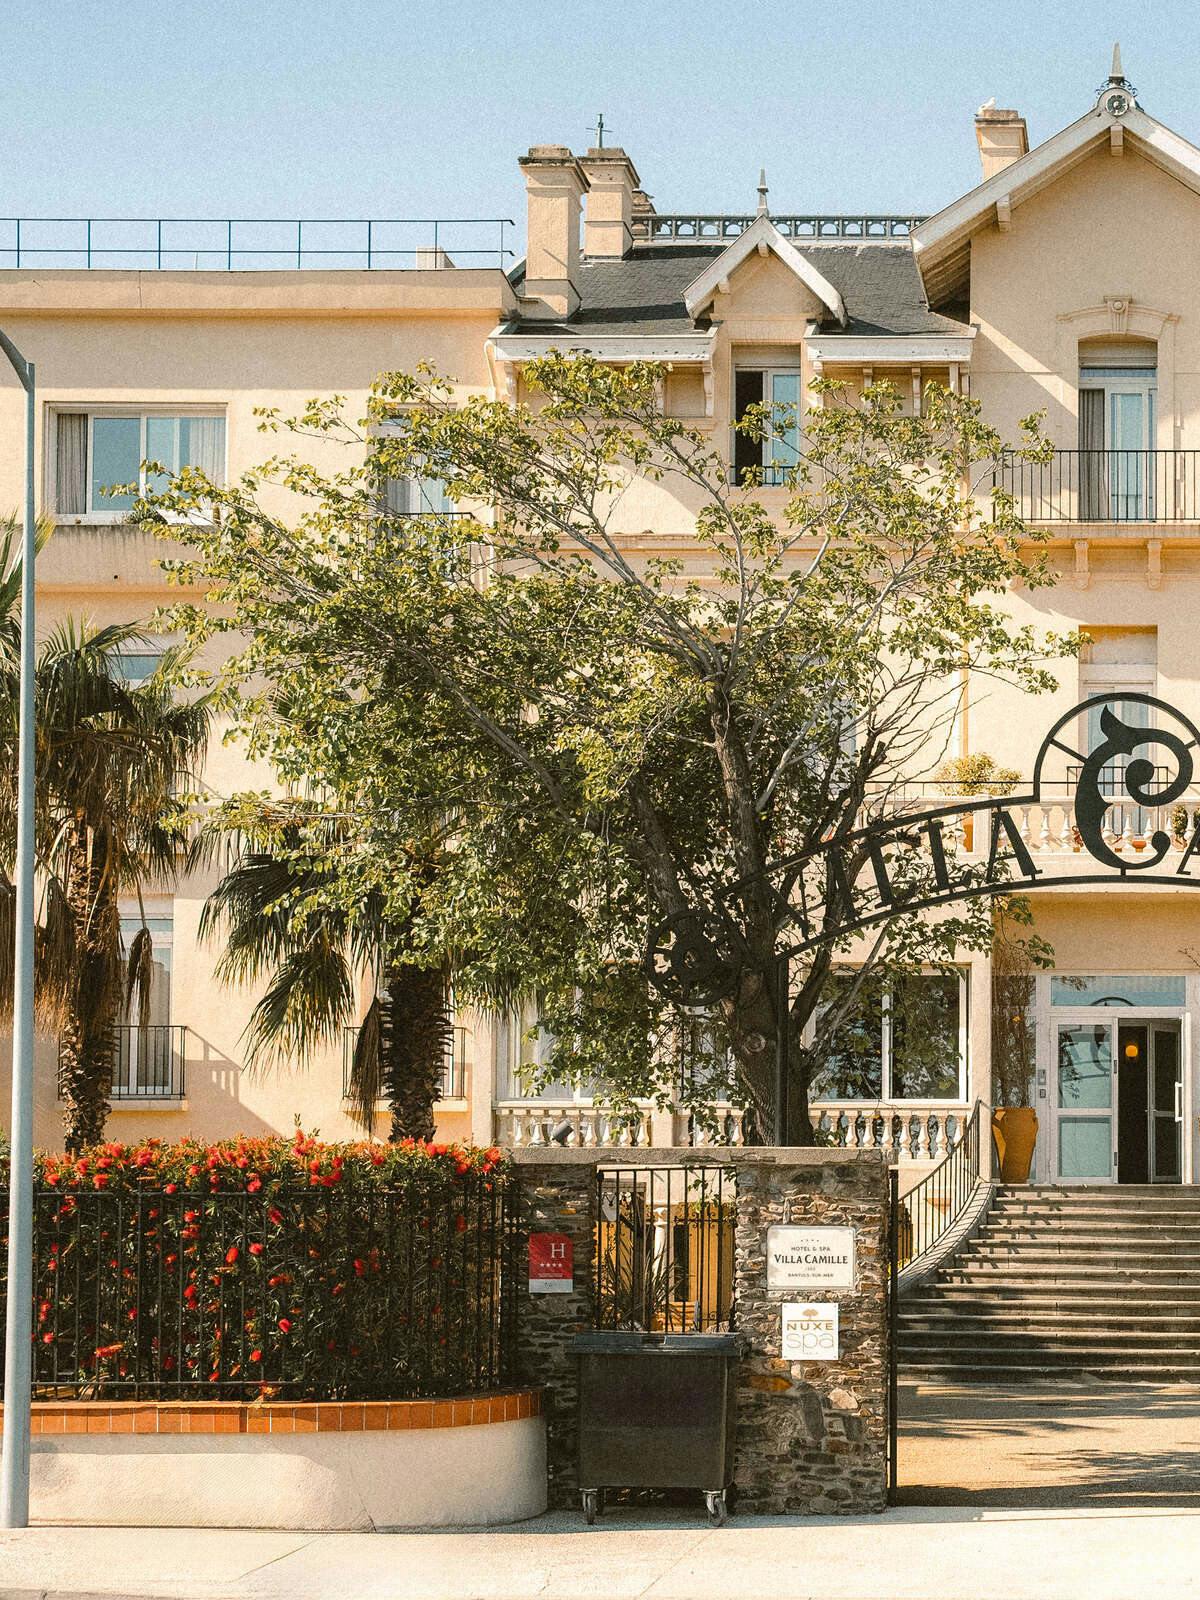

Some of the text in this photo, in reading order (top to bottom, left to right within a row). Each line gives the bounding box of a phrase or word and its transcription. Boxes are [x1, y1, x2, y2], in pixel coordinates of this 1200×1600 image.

[550, 1243, 566, 1258] H
[774, 1254, 848, 1264] VILLA CAMILLE
[786, 1322, 834, 1331] NUXE
[786, 1333, 834, 1352] spa
